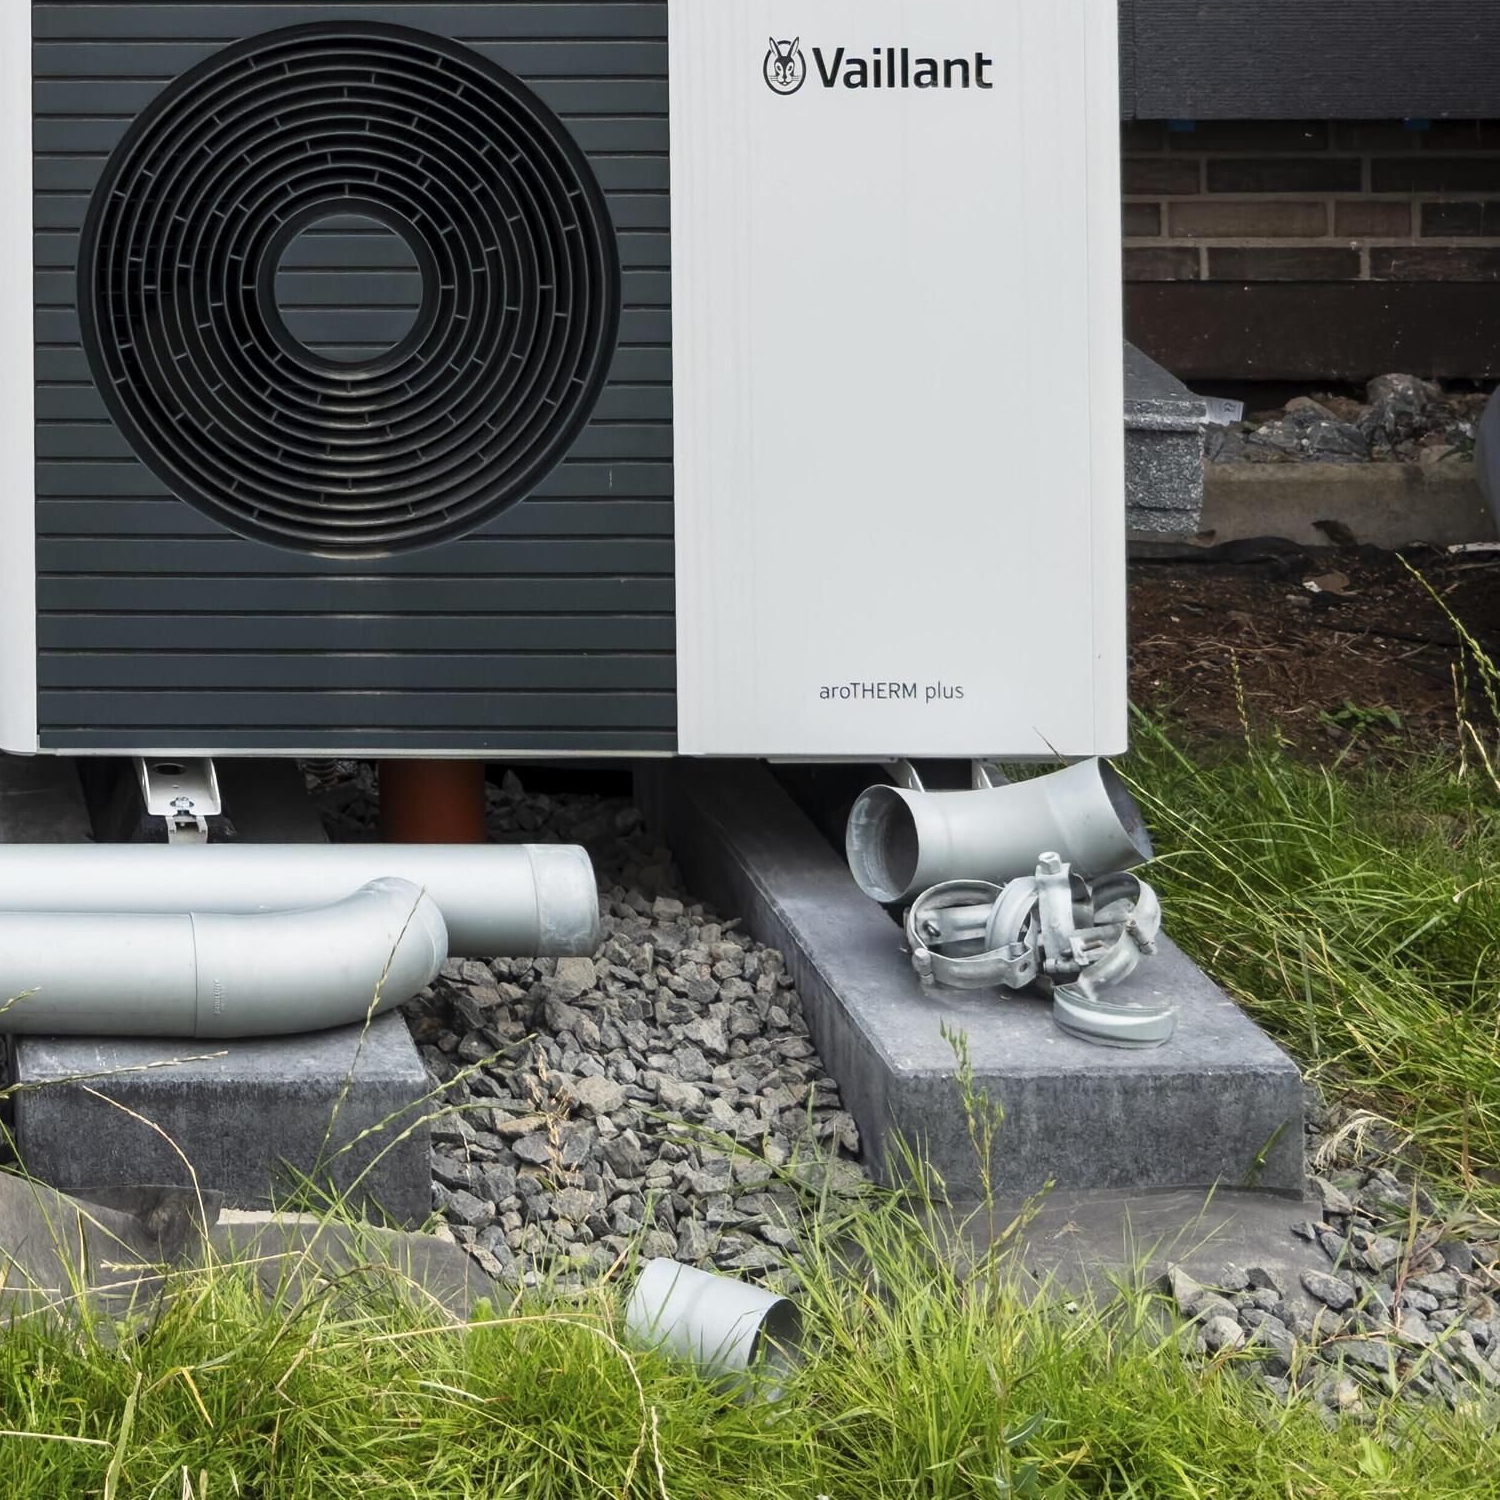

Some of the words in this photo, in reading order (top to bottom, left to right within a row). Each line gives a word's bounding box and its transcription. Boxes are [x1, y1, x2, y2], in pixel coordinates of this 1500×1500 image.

[812, 47, 993, 90] Vaillant
[819, 682, 917, 699] aroTHERM
[925, 681, 964, 704] plus
